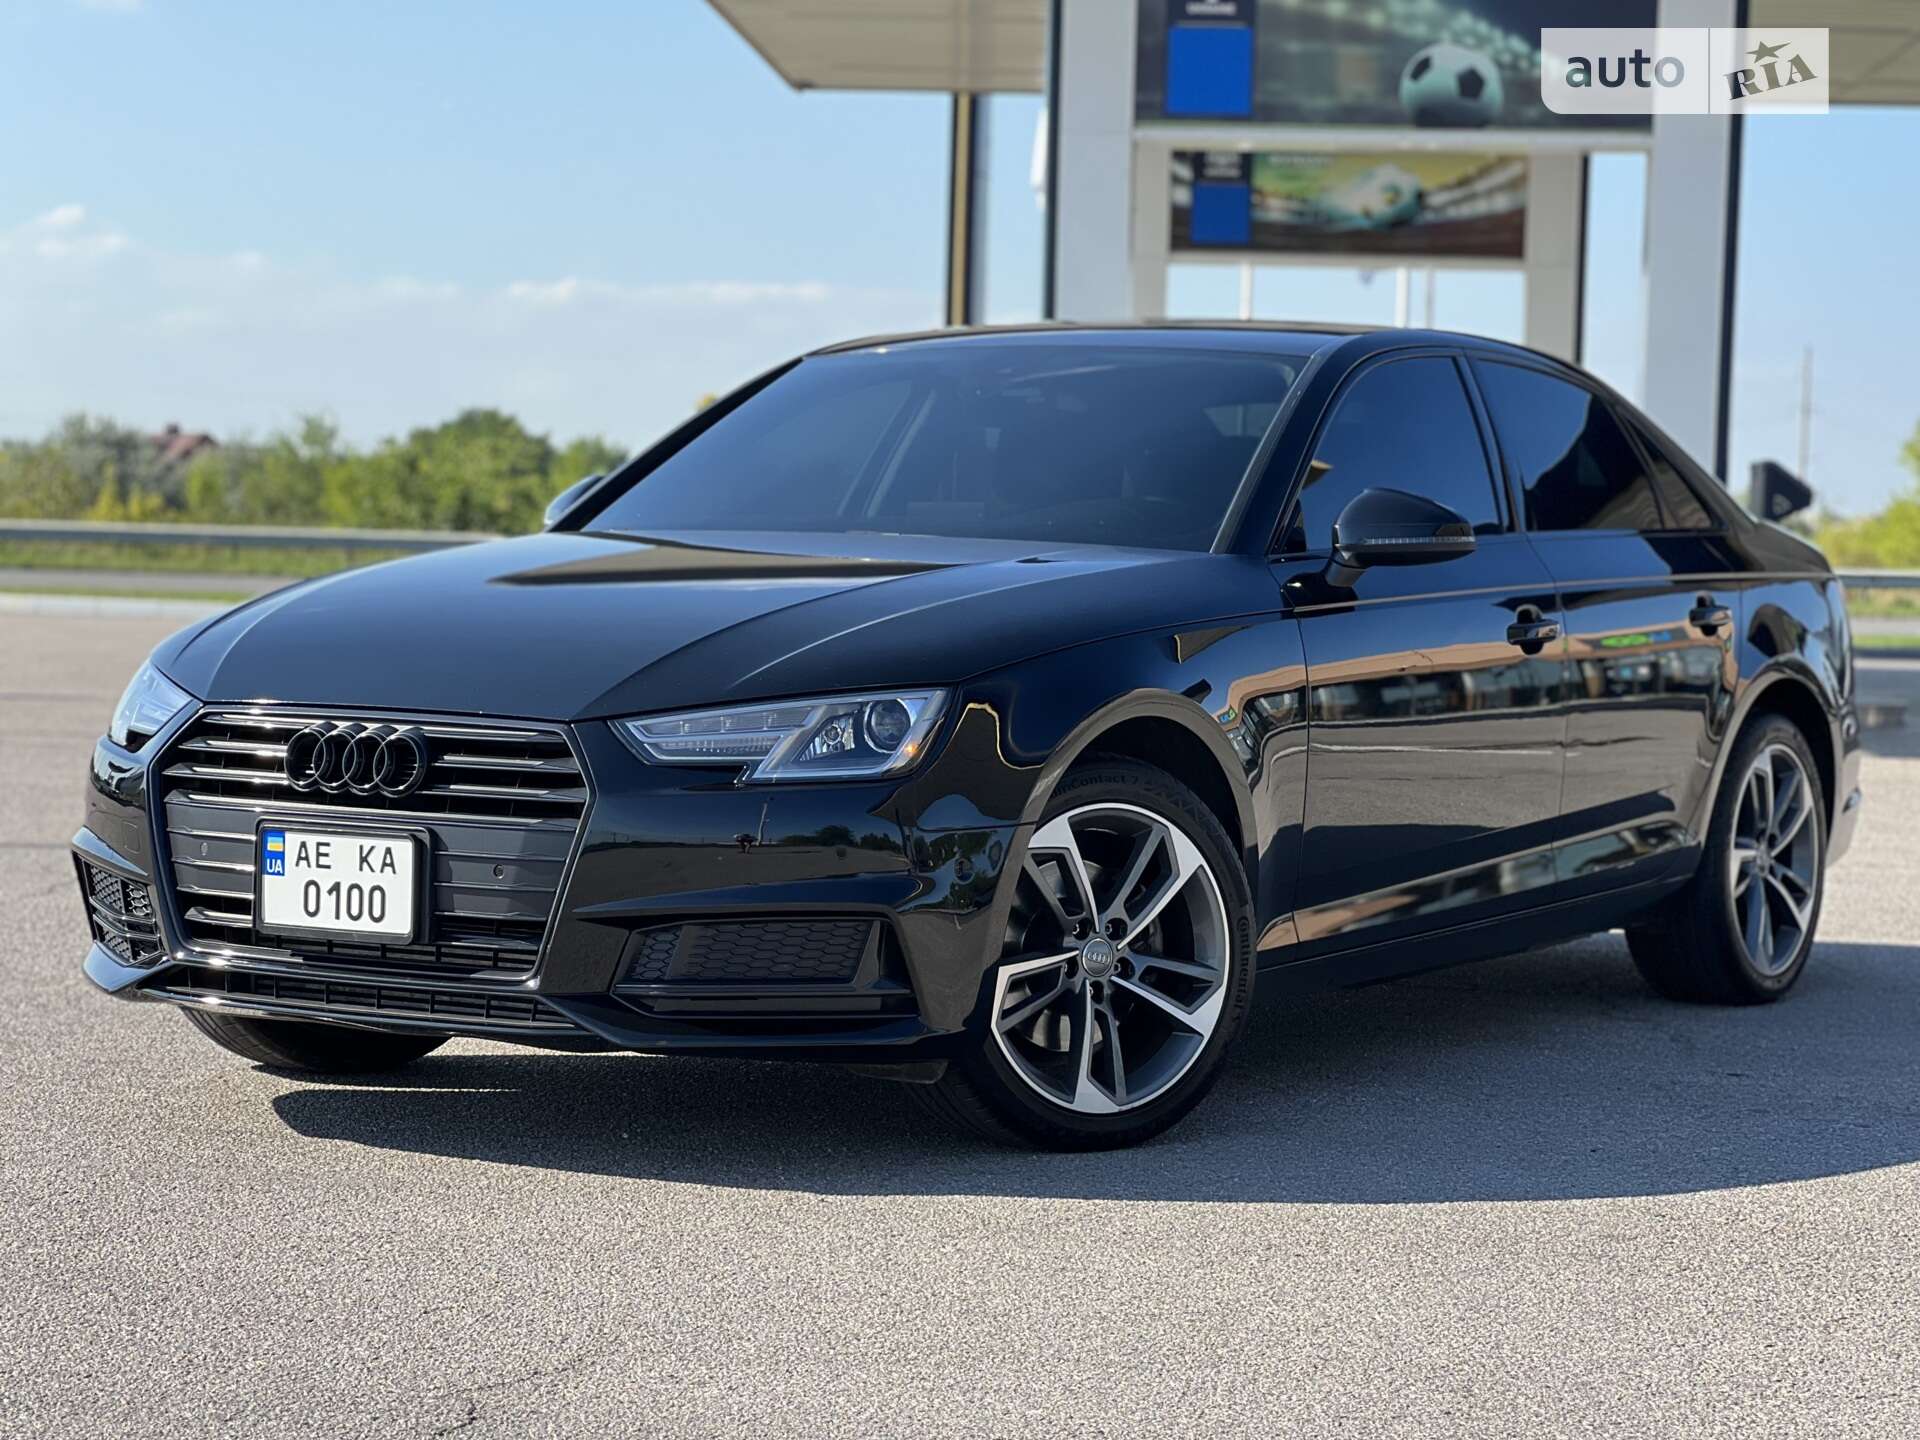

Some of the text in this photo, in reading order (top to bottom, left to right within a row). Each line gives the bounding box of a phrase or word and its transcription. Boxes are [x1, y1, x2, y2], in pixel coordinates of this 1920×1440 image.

[266, 859, 283, 873] UA
[295, 841, 397, 875] AE KA
[303, 879, 387, 923] 0100
